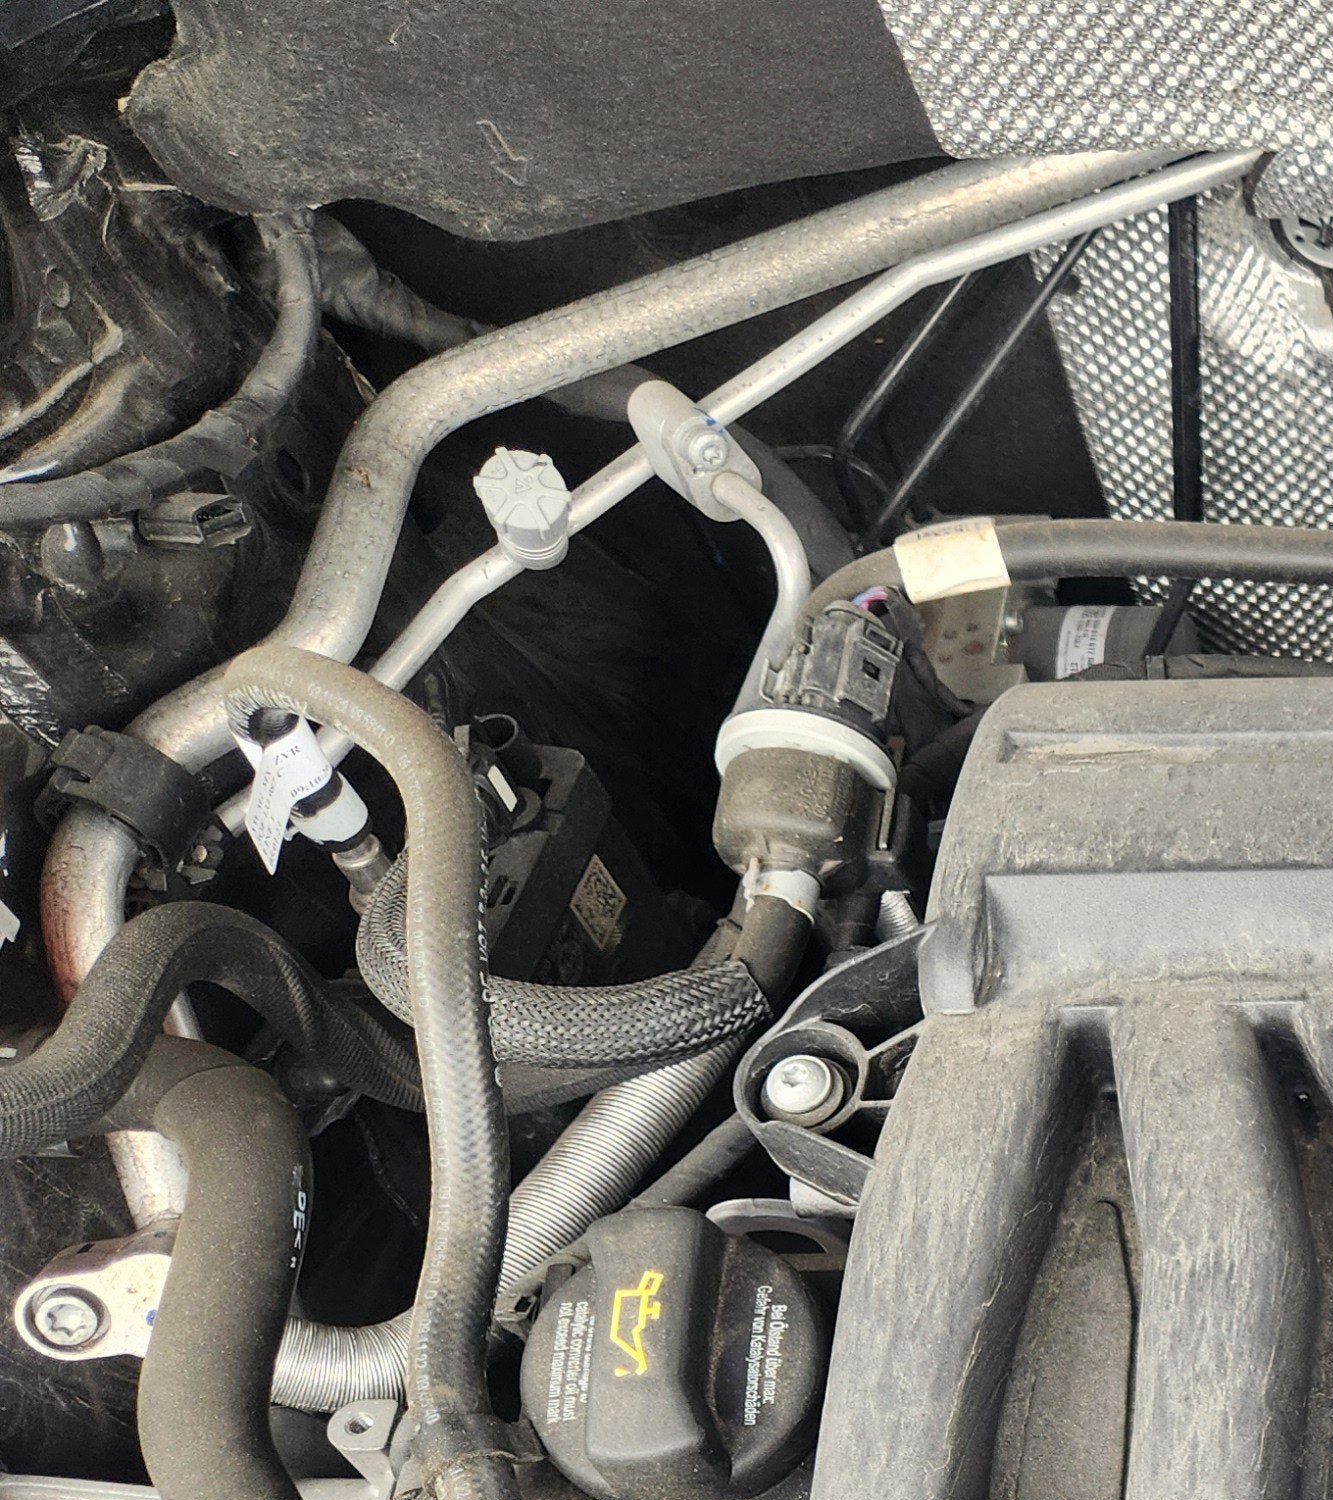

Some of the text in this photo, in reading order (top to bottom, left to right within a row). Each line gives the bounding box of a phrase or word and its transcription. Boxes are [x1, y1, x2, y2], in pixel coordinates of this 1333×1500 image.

[546, 1302, 572, 1424] not exceed maximum mark
[563, 1301, 589, 1421] catalytic converter oil must
[744, 1285, 773, 1426] Gefahr von Katalysatorschäden
[765, 1357, 782, 1379] über
[771, 1304, 788, 1320] Bei
